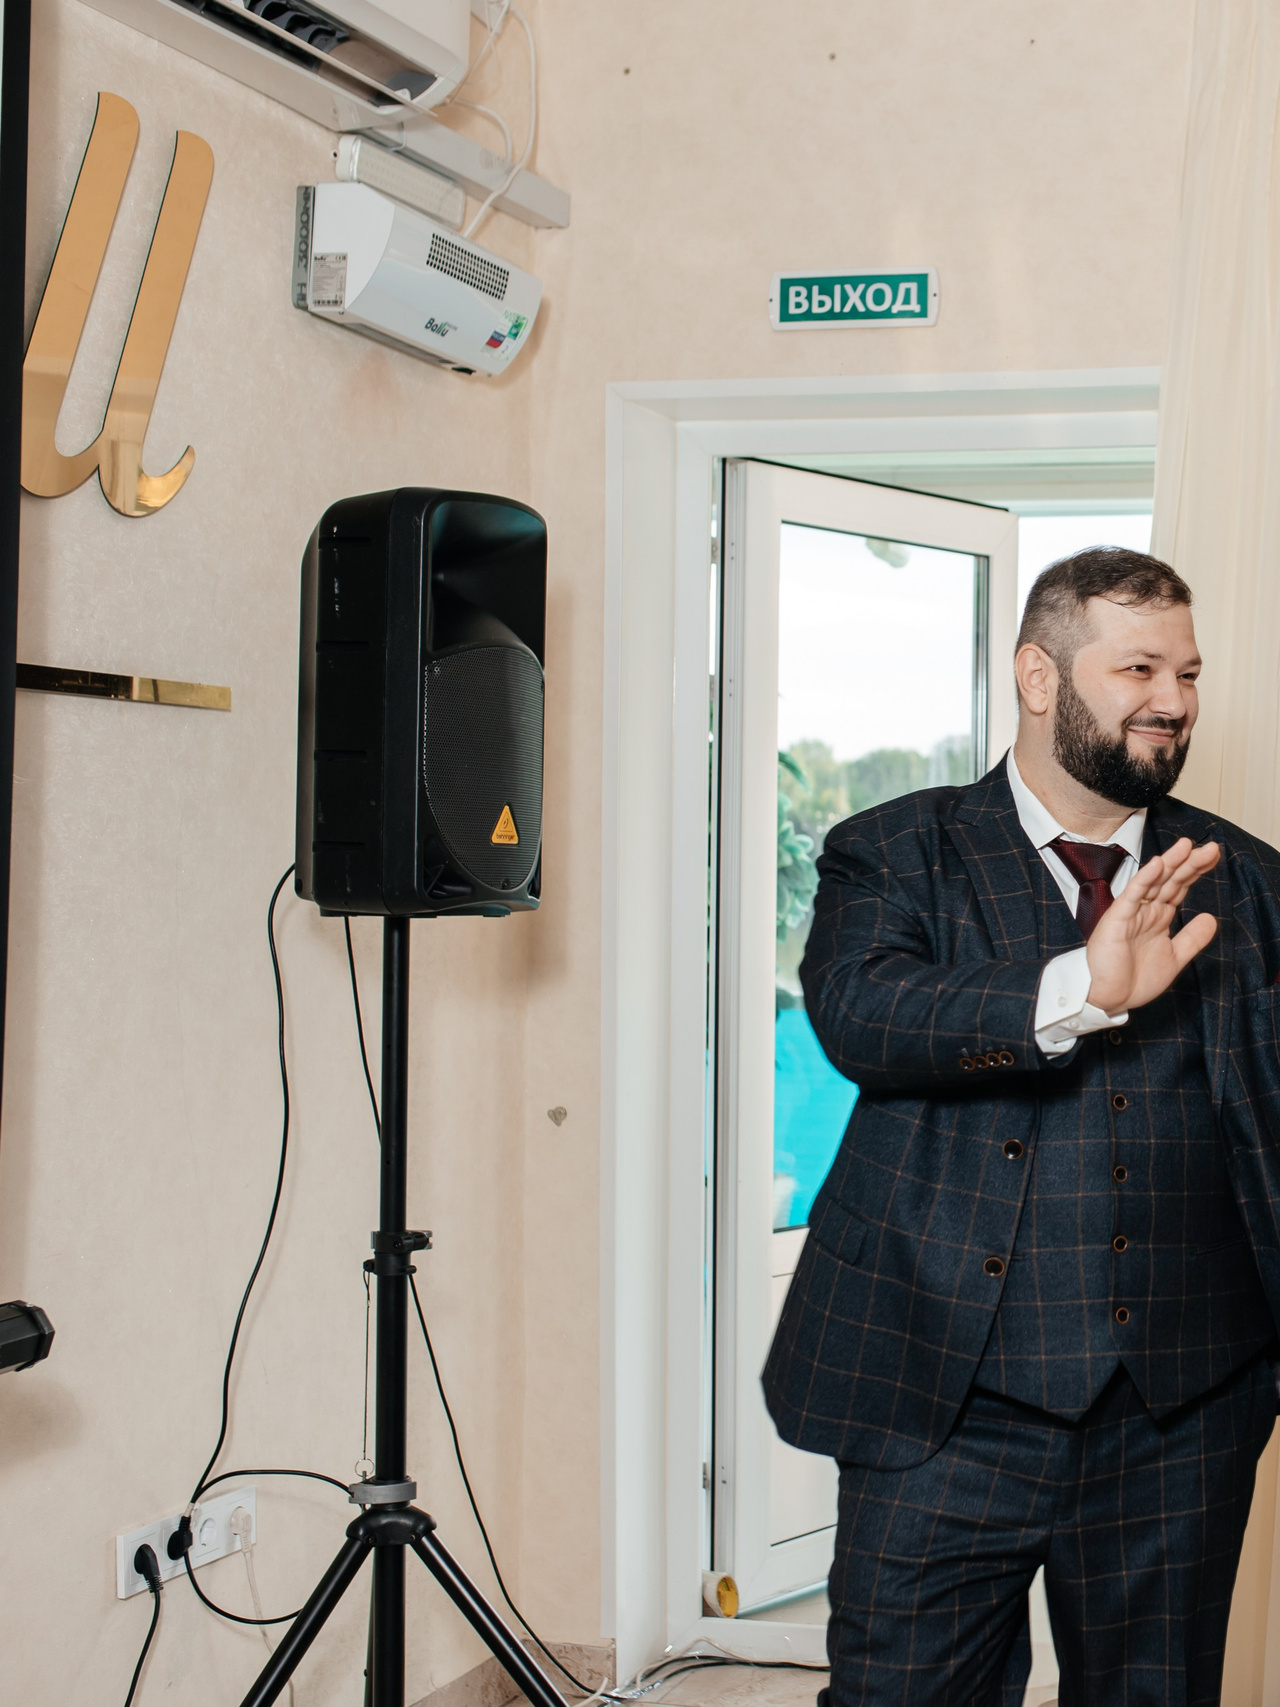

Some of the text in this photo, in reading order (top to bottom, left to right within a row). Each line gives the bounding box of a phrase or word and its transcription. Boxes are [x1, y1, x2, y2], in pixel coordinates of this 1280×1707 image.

[788, 282, 921, 314] ВЫХОД
[424, 317, 449, 337] Ballu
[496, 833, 516, 842] behringer
